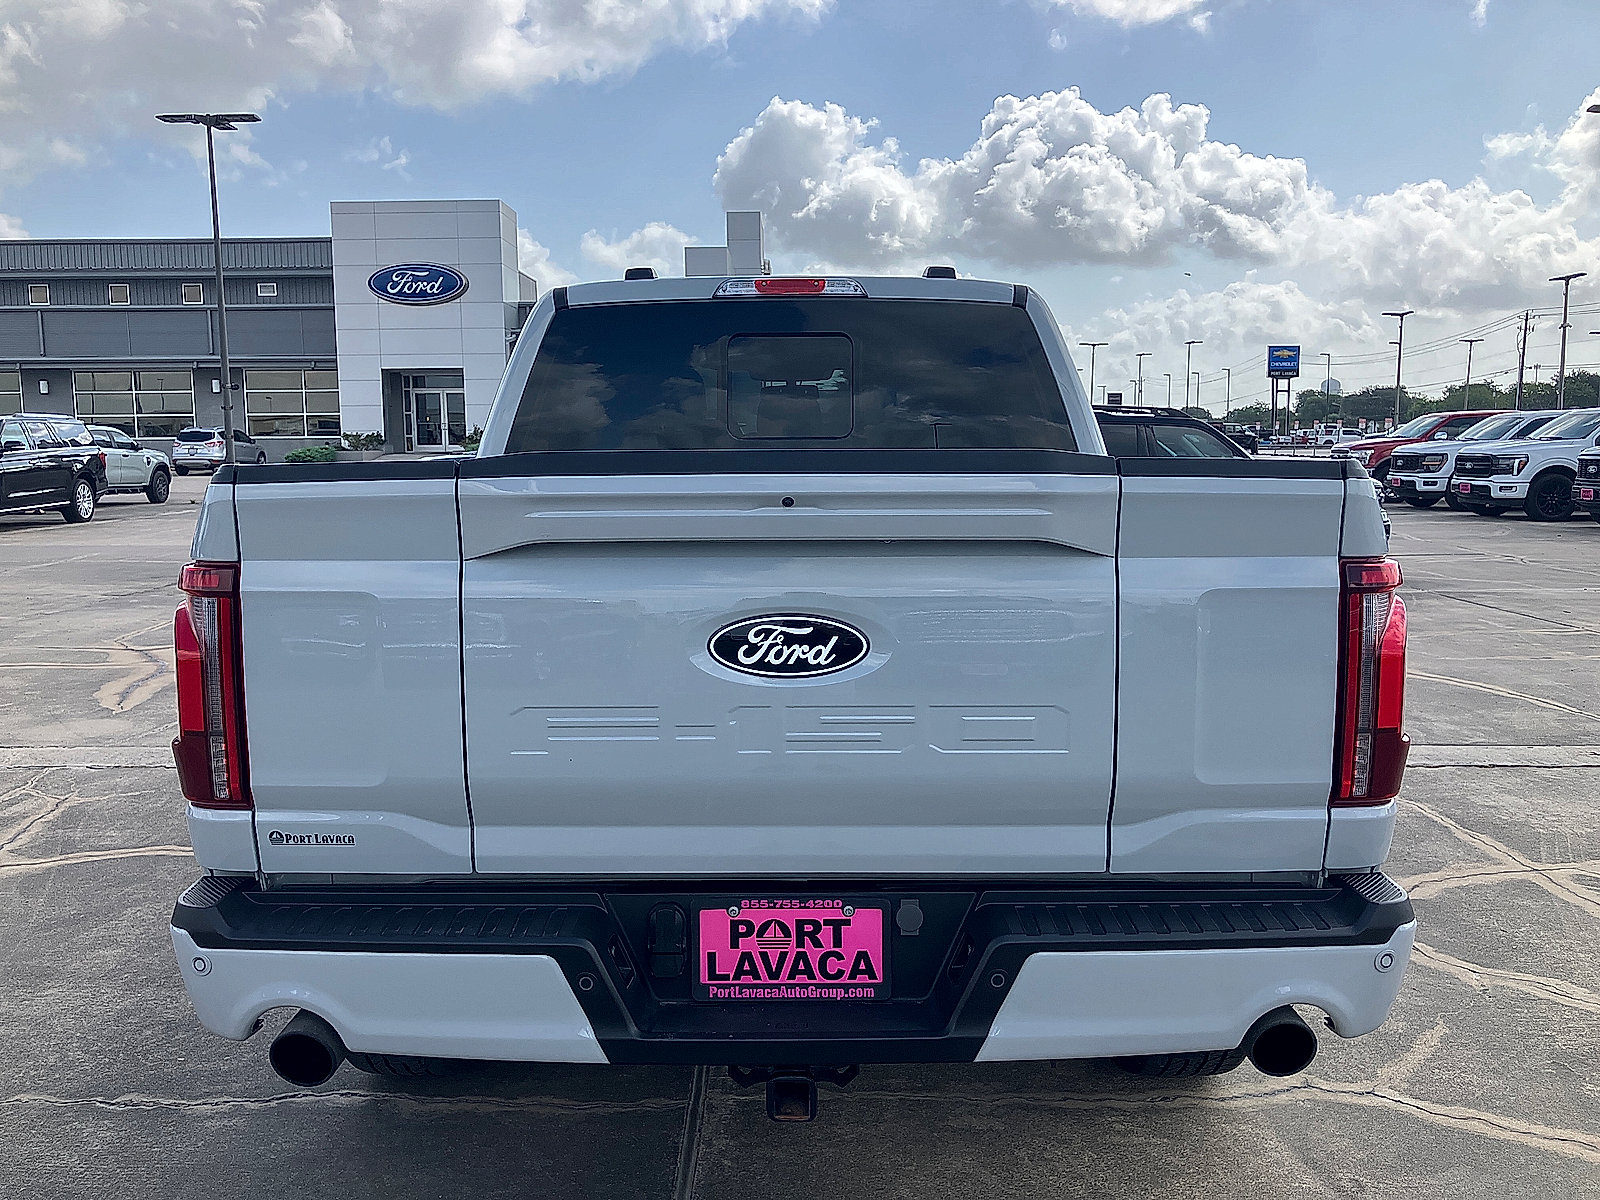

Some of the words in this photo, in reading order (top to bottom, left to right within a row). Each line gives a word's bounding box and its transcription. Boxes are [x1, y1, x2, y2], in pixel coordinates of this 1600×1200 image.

[387, 270, 443, 294] Ford
[737, 624, 839, 665] Ford
[284, 833, 312, 844] PORT
[314, 833, 355, 844] LAVACA
[740, 899, 843, 909] 855-755-4200
[729, 918, 852, 950] PORT
[706, 950, 880, 982] LAVACA
[708, 985, 875, 1000] PortLavacaAutoGroup.com
